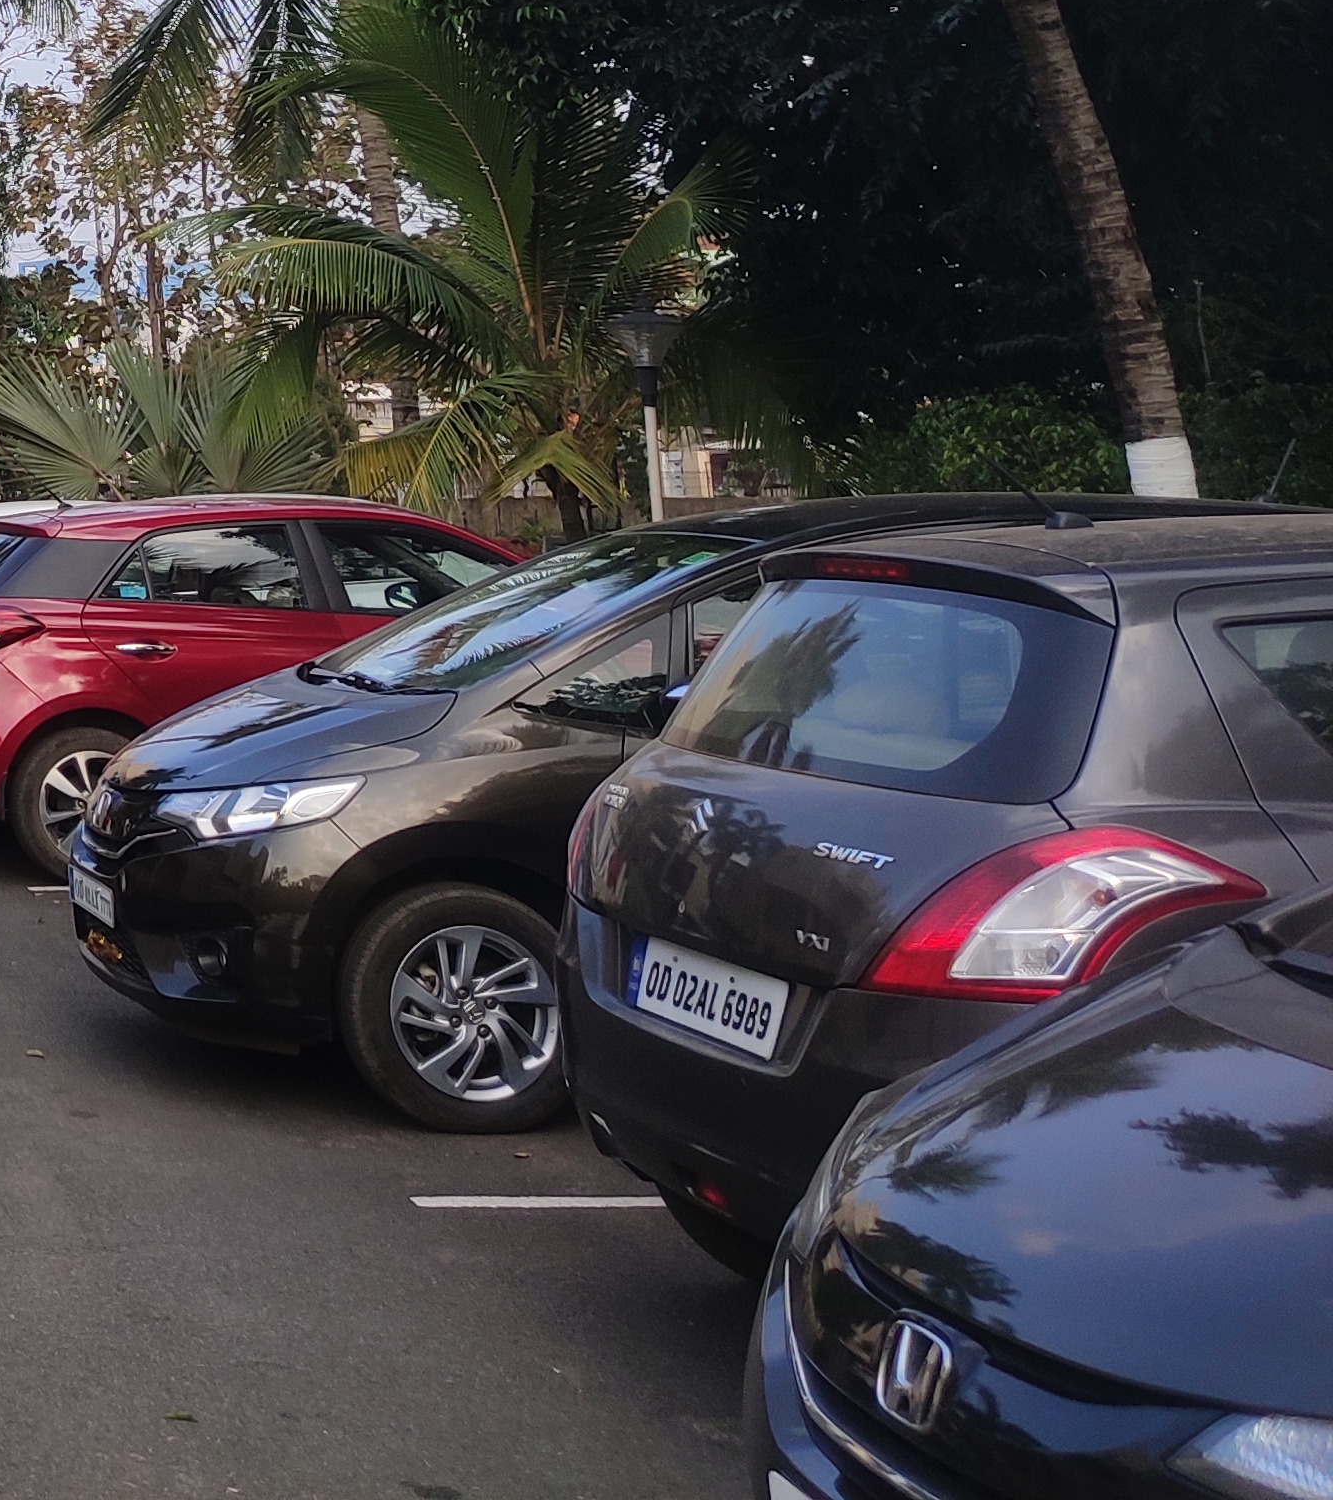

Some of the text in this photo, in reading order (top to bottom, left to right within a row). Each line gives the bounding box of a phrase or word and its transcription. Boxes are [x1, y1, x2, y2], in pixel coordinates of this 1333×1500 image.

[813, 842, 895, 869] SWIFT
[645, 960, 672, 1002] OD
[672, 970, 719, 1022] 02AL
[720, 989, 772, 1040] 6989
